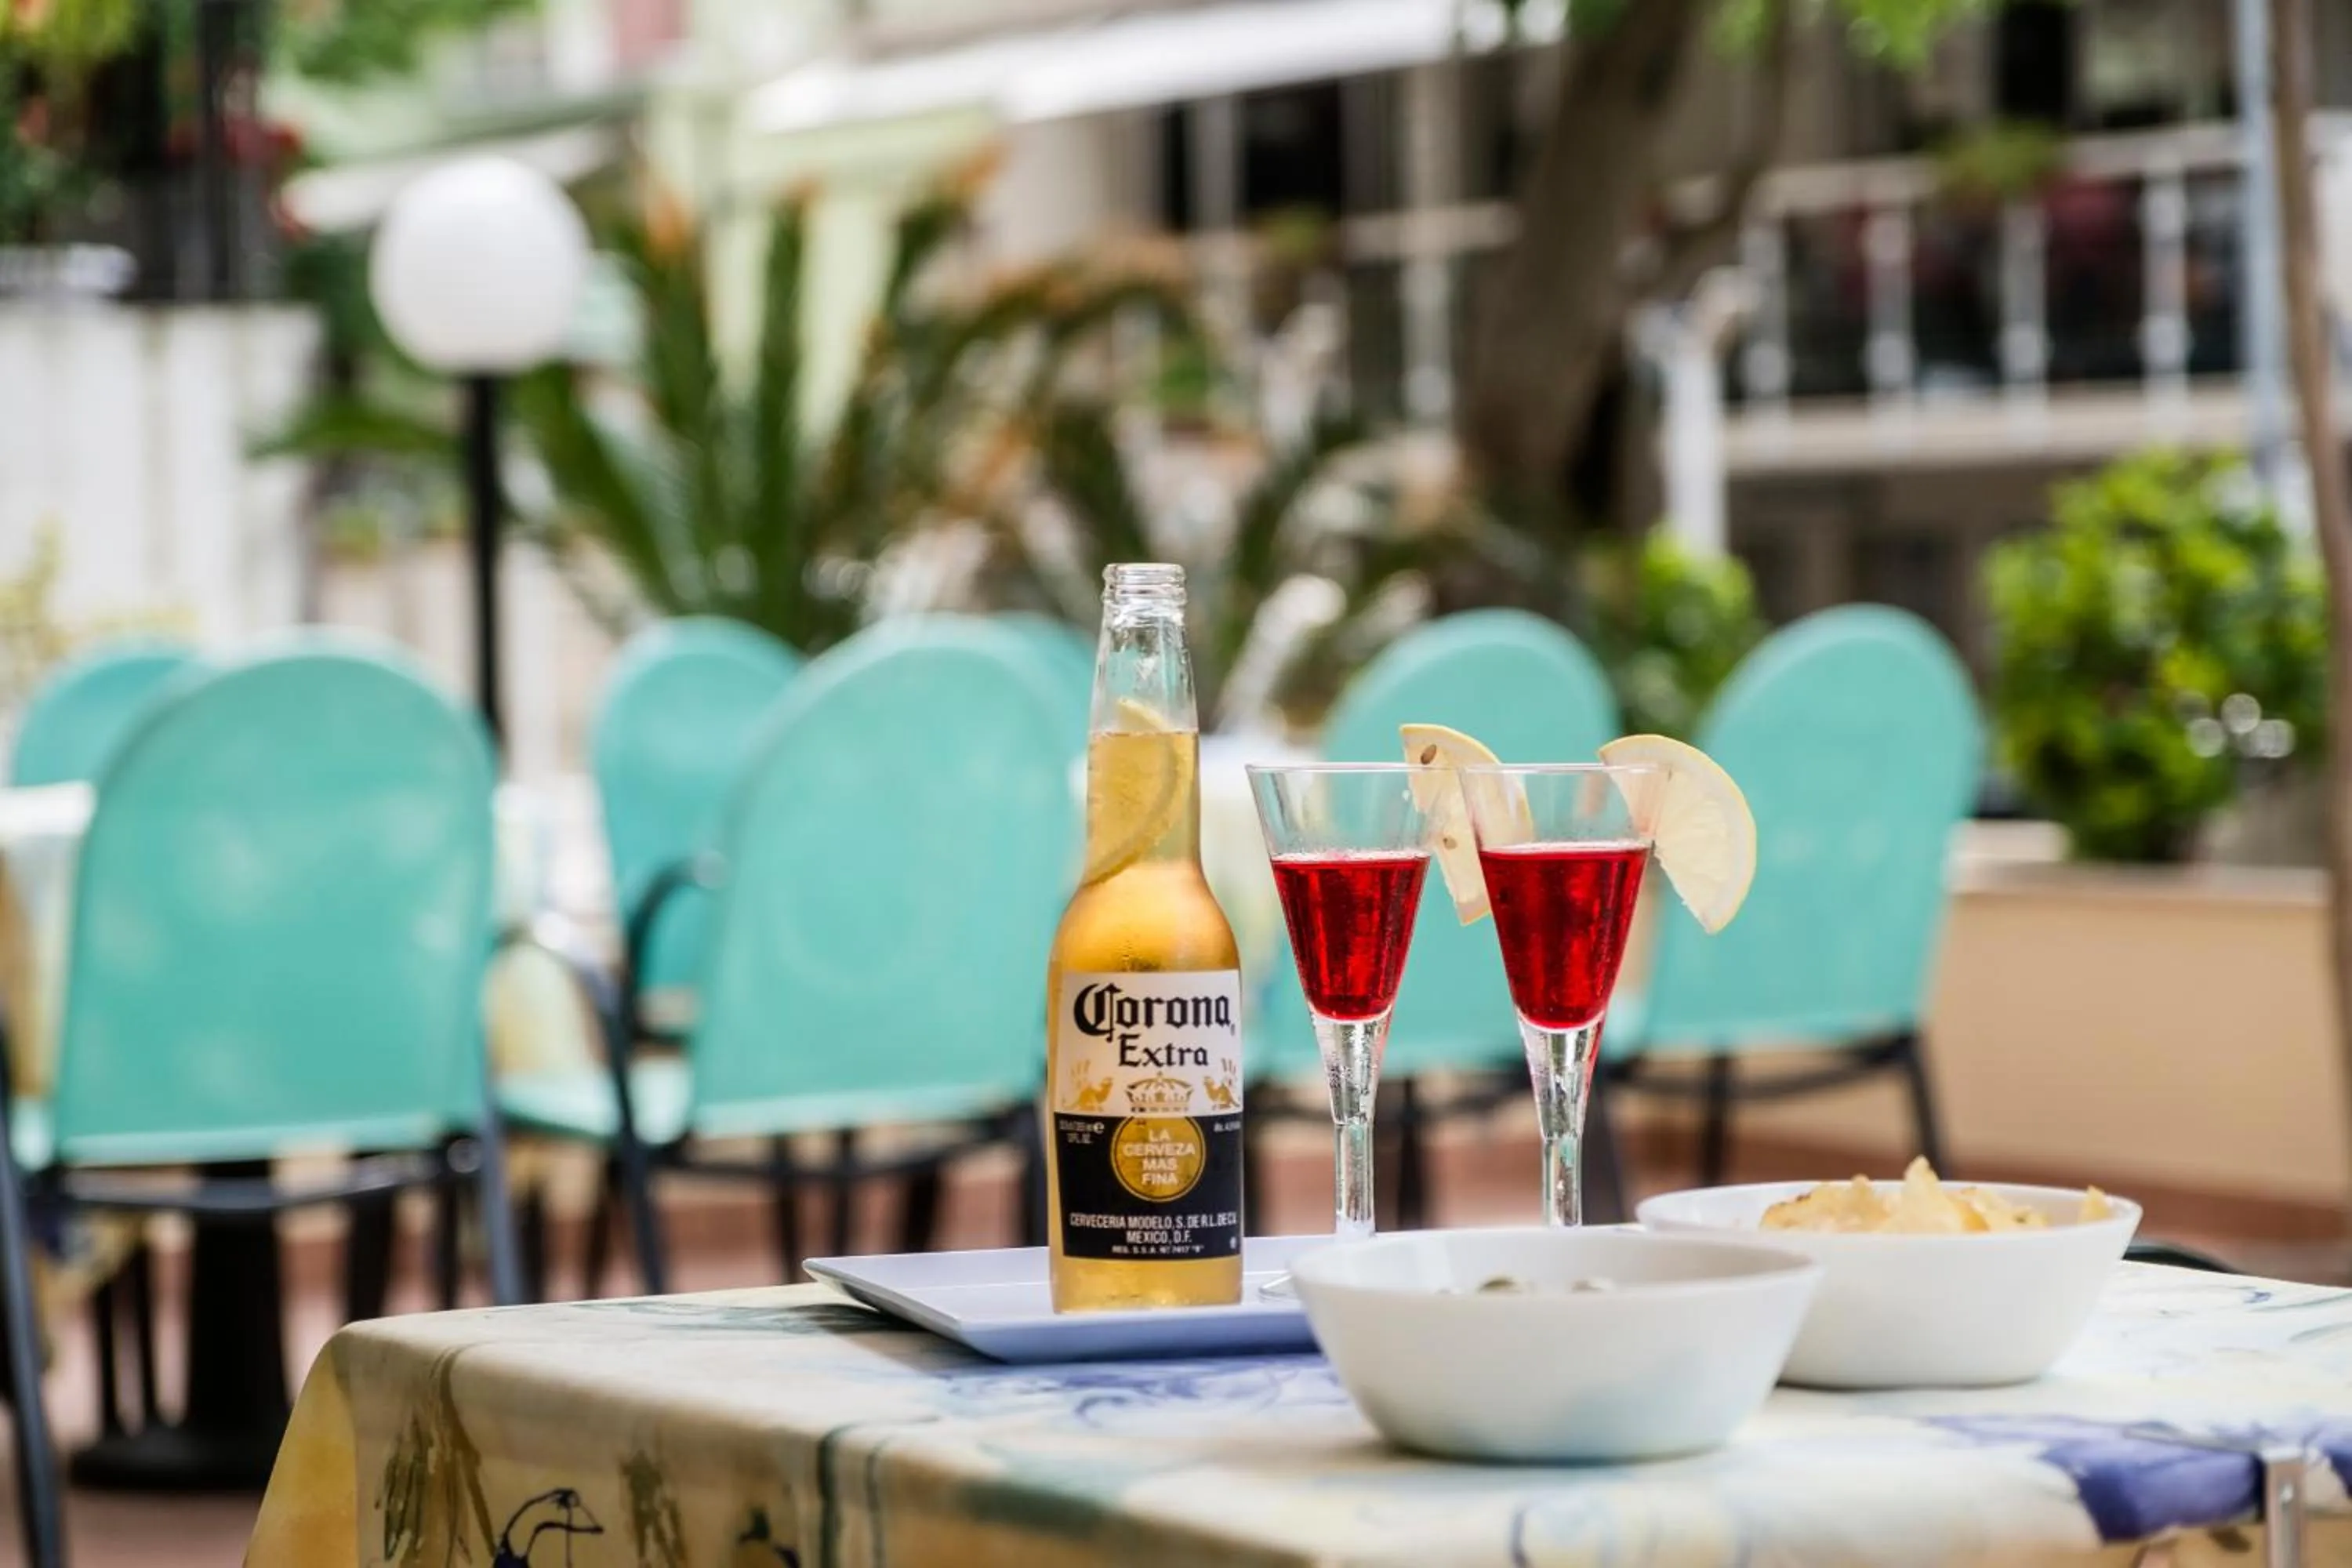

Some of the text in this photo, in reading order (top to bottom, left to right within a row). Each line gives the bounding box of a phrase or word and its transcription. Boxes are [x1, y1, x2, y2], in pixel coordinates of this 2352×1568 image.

[1073, 983, 1231, 1042] Corona
[1118, 1033, 1208, 1067] Extra
[1148, 1129, 1171, 1142] LA
[1123, 1142, 1196, 1157] CERVEZA
[1142, 1157, 1178, 1171] MAS
[1142, 1171, 1178, 1185] FINA
[1070, 1213, 1125, 1229] CERVECERIA
